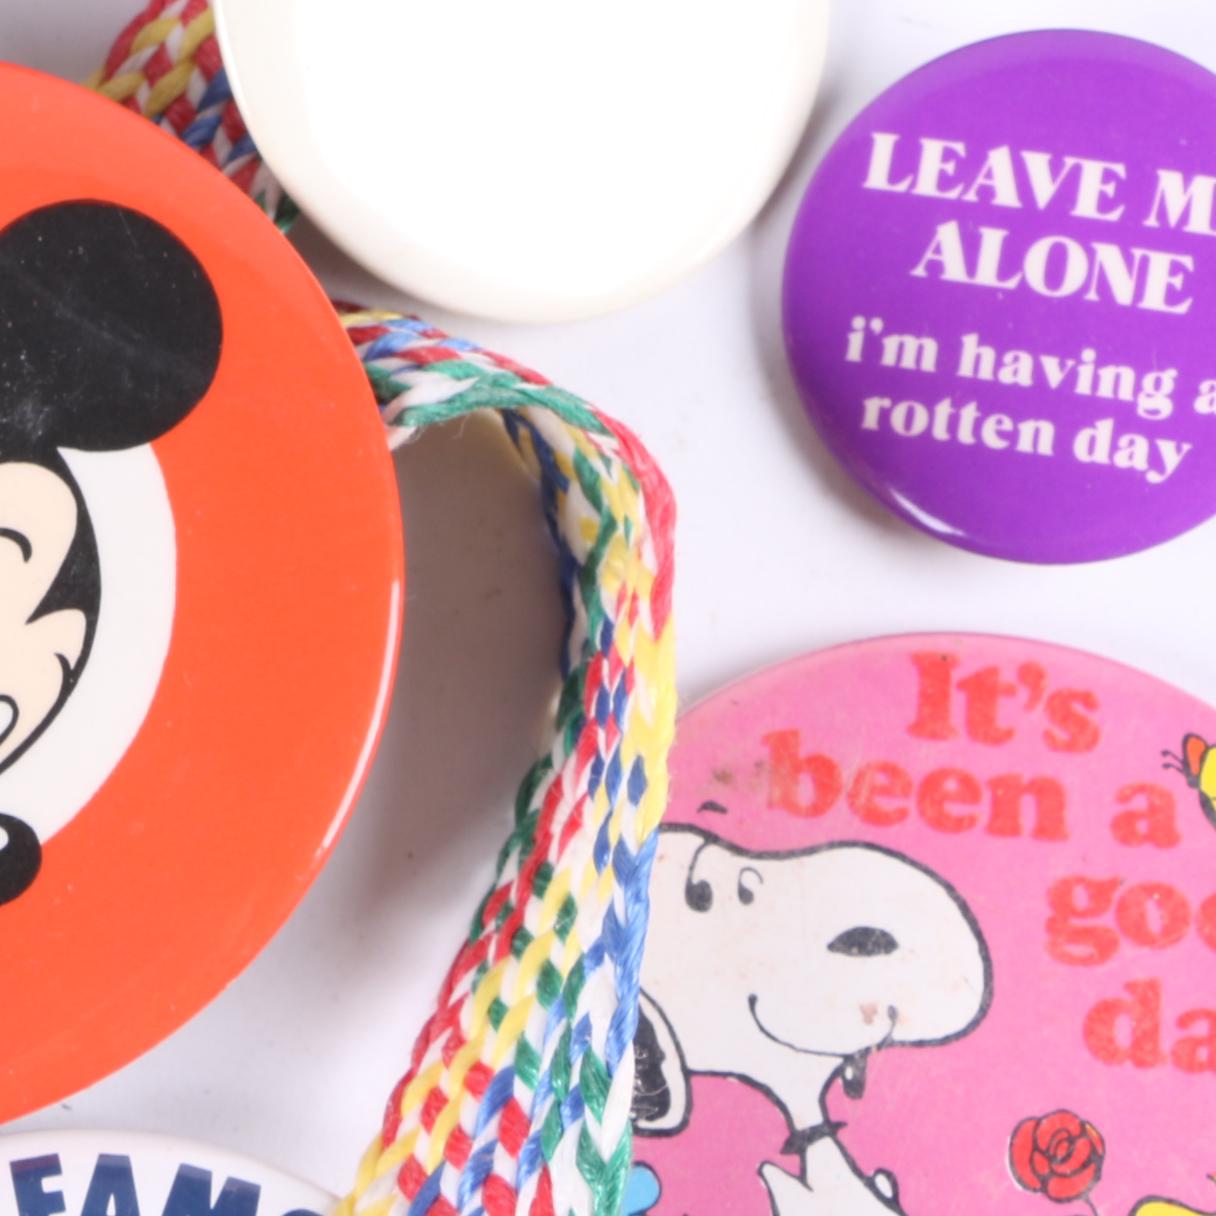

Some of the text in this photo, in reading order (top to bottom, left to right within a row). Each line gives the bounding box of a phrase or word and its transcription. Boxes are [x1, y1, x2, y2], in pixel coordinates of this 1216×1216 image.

[863, 132, 1126, 221] LEAVE
[910, 219, 1195, 315] ALONE
[957, 333, 1178, 419] having
[861, 393, 1192, 484] rotten day
[761, 729, 1182, 849] been a
[1046, 874, 1216, 968] go
